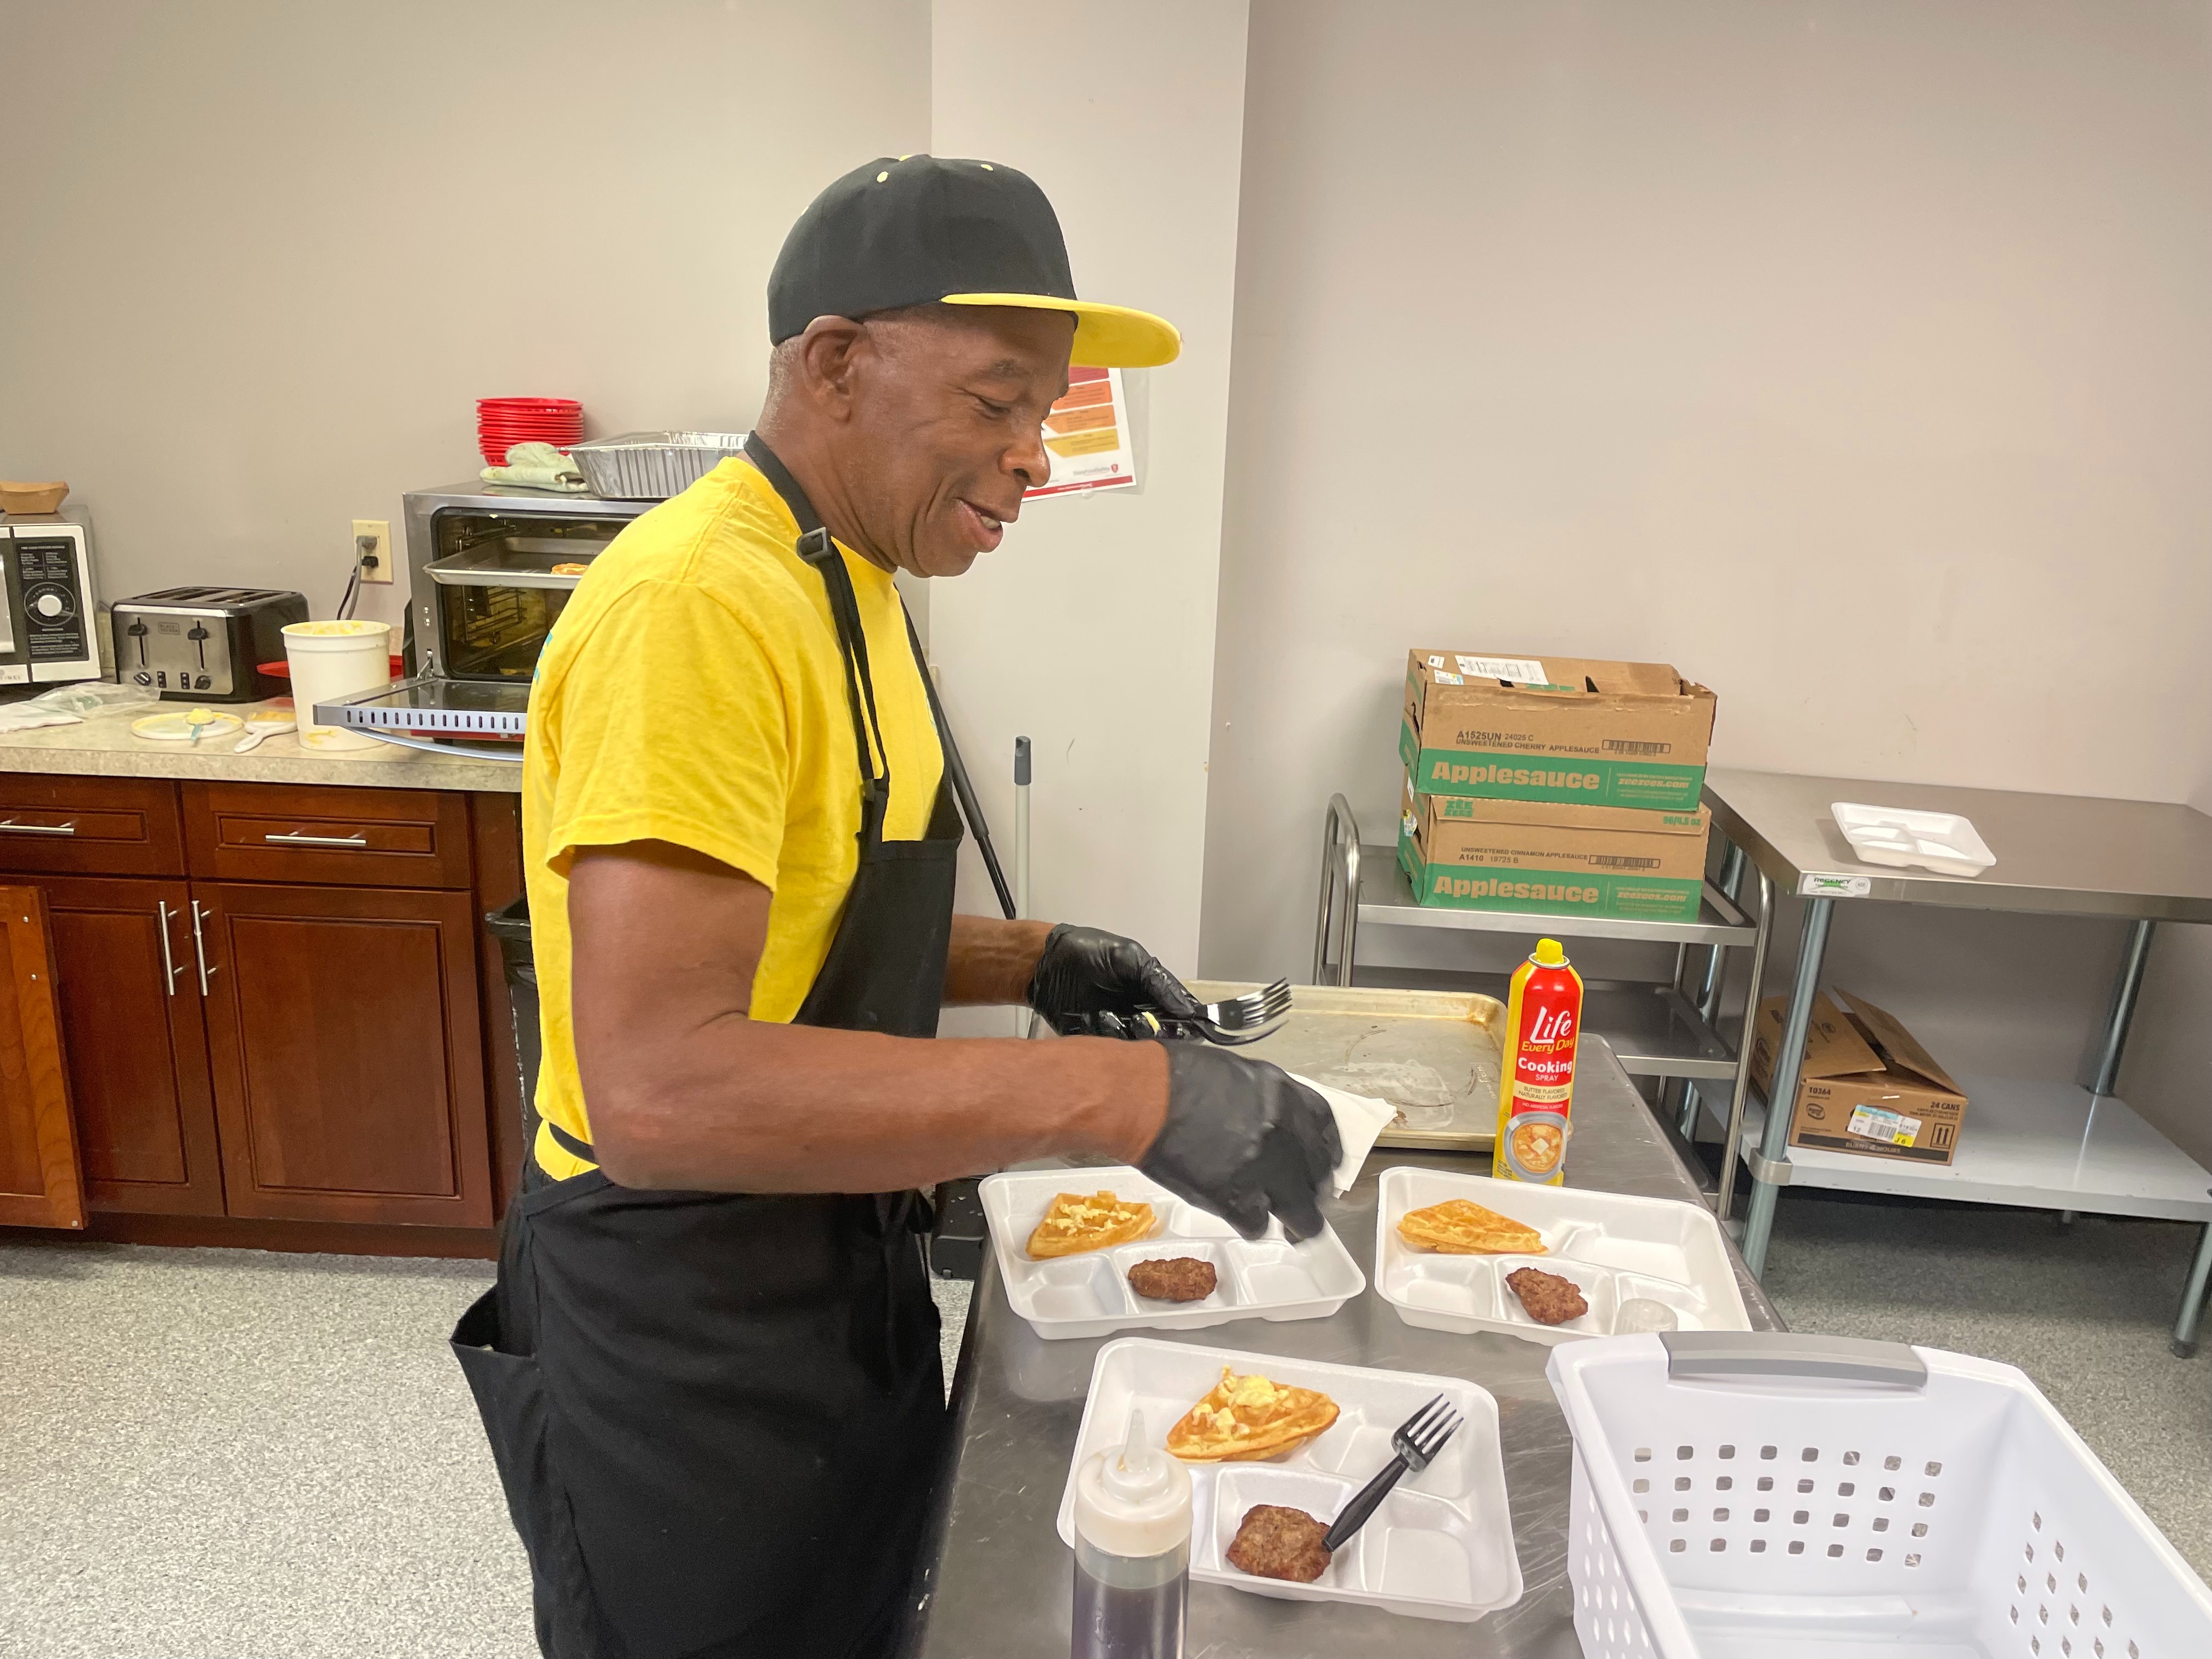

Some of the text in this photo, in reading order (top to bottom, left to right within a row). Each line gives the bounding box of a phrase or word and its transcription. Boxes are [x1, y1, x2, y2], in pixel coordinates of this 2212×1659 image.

[1457, 730, 1502, 741] A1525UN
[1456, 738, 1600, 754] UNSWEETENED CHERRY APPLESAUCE
[1431, 761, 1600, 789] Applesauce
[1462, 847, 1509, 855] UNSWEETENED
[1545, 852, 1588, 860] APPLESAUCE
[1433, 876, 1599, 904] Applesauce
[1530, 1005, 1572, 1044] Life
[1521, 1037, 1575, 1054] Every Day
[1518, 1057, 1573, 1074] Cooking
[1519, 1090, 1545, 1100] NATURALLY
[1523, 1086, 1542, 1094] BUTTER
[1941, 1103, 1961, 1111] CANS
